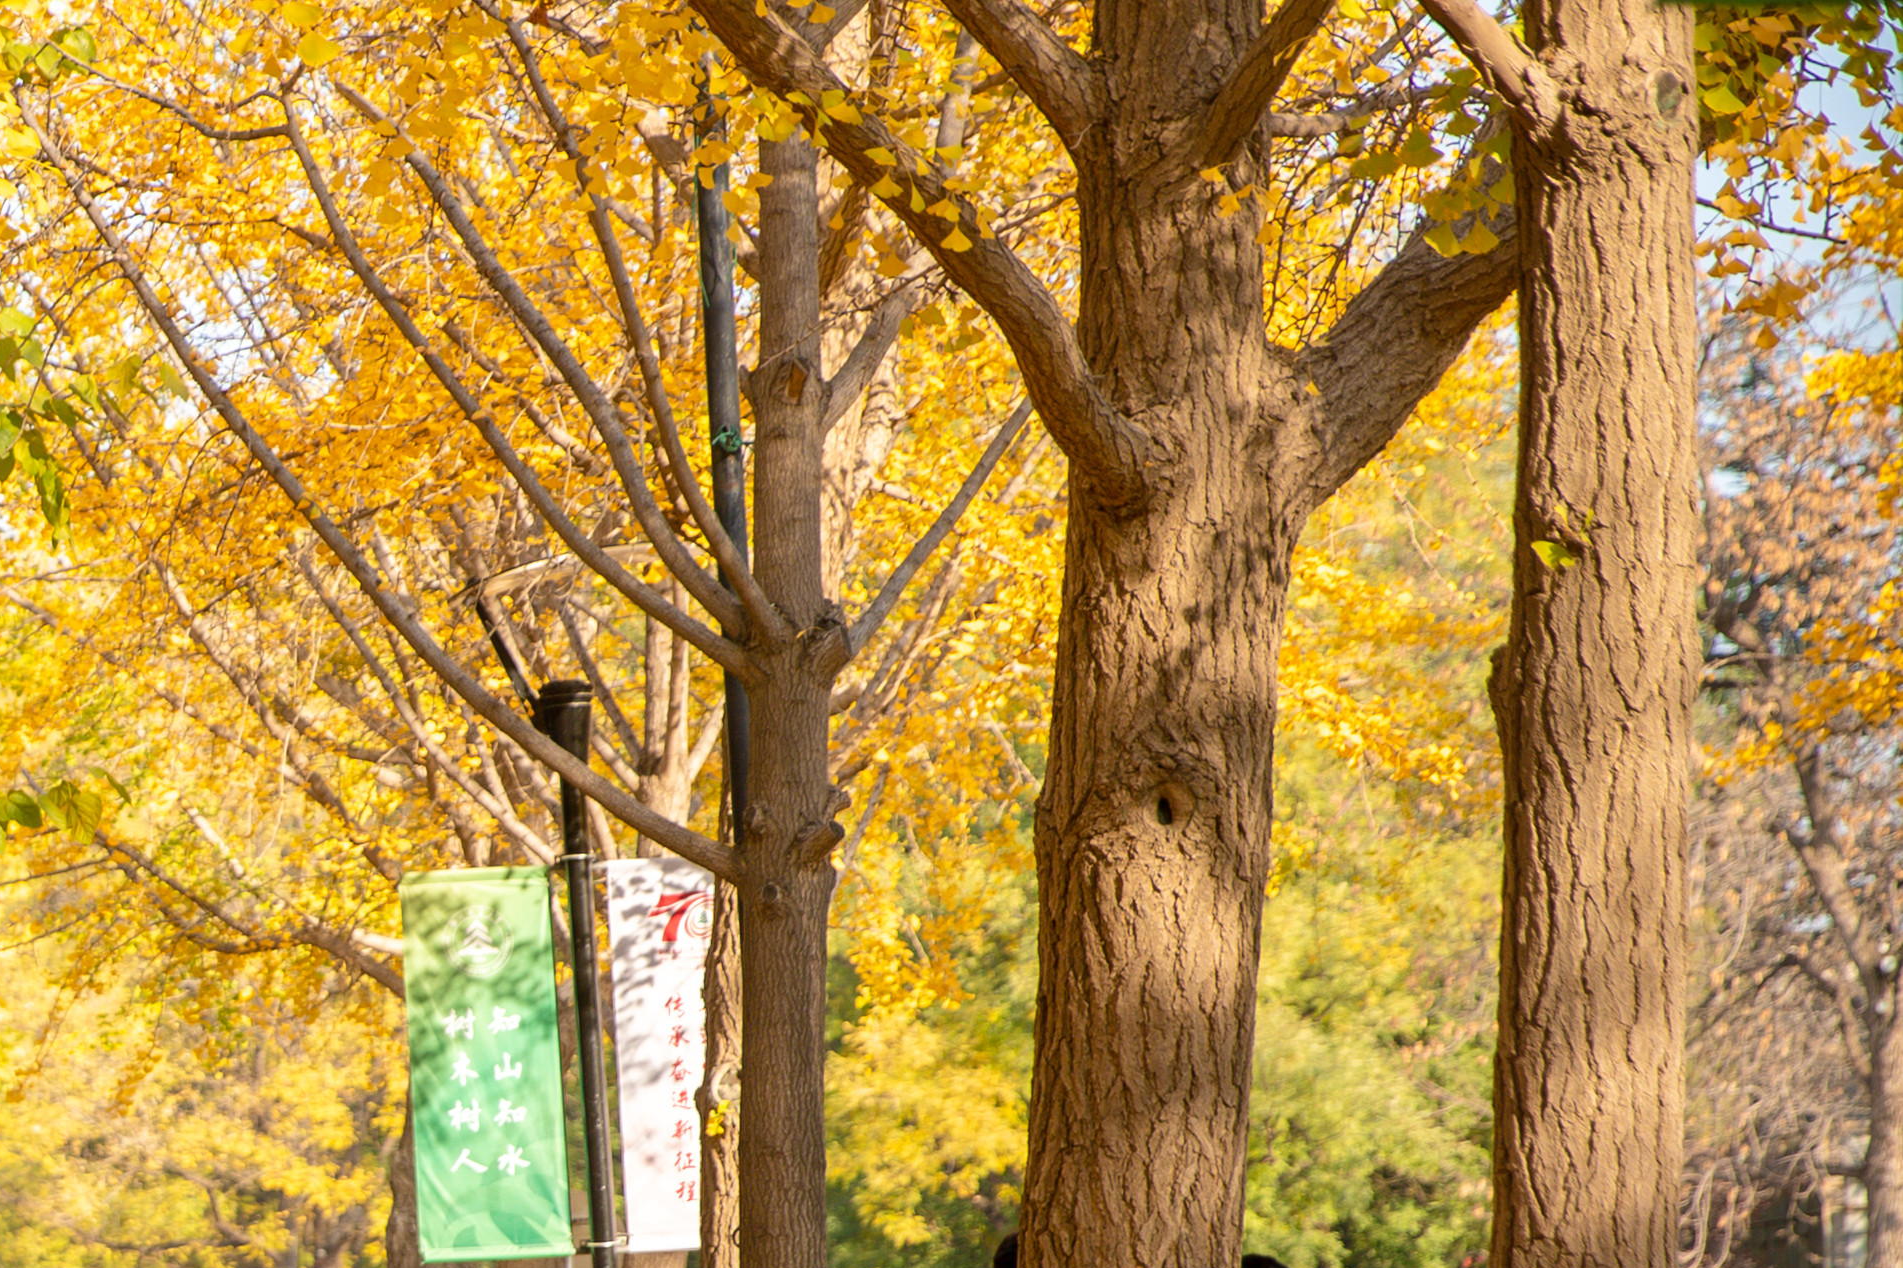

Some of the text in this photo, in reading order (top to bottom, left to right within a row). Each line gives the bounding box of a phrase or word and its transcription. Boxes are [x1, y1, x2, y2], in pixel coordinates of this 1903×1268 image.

[443, 1007, 489, 1175] 树木树人
[488, 1006, 531, 1176] 知山知水
[664, 993, 698, 1202] 传承奋进新征程
